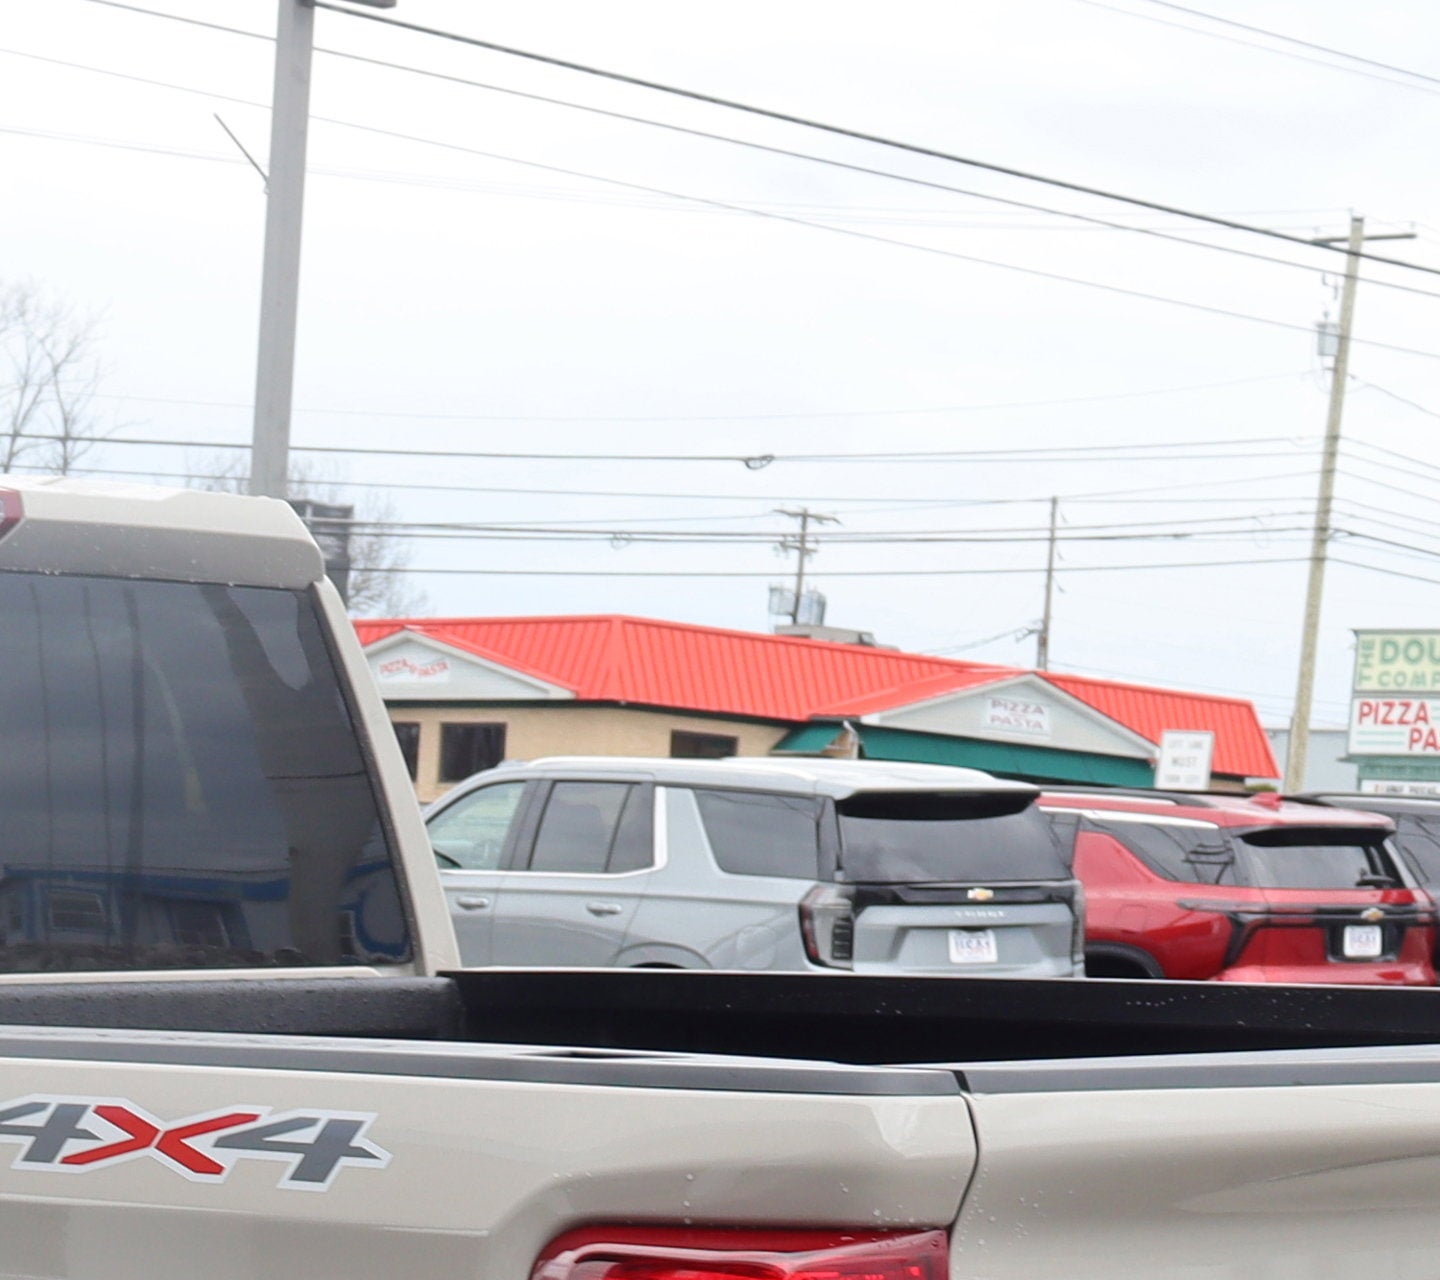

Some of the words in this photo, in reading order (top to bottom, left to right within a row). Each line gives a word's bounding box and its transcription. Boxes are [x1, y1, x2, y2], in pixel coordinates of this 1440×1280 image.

[1359, 640, 1375, 686] THE
[991, 698, 1044, 715] PIZZA
[1358, 701, 1430, 725] PIZZA
[991, 714, 1044, 730] PASTA
